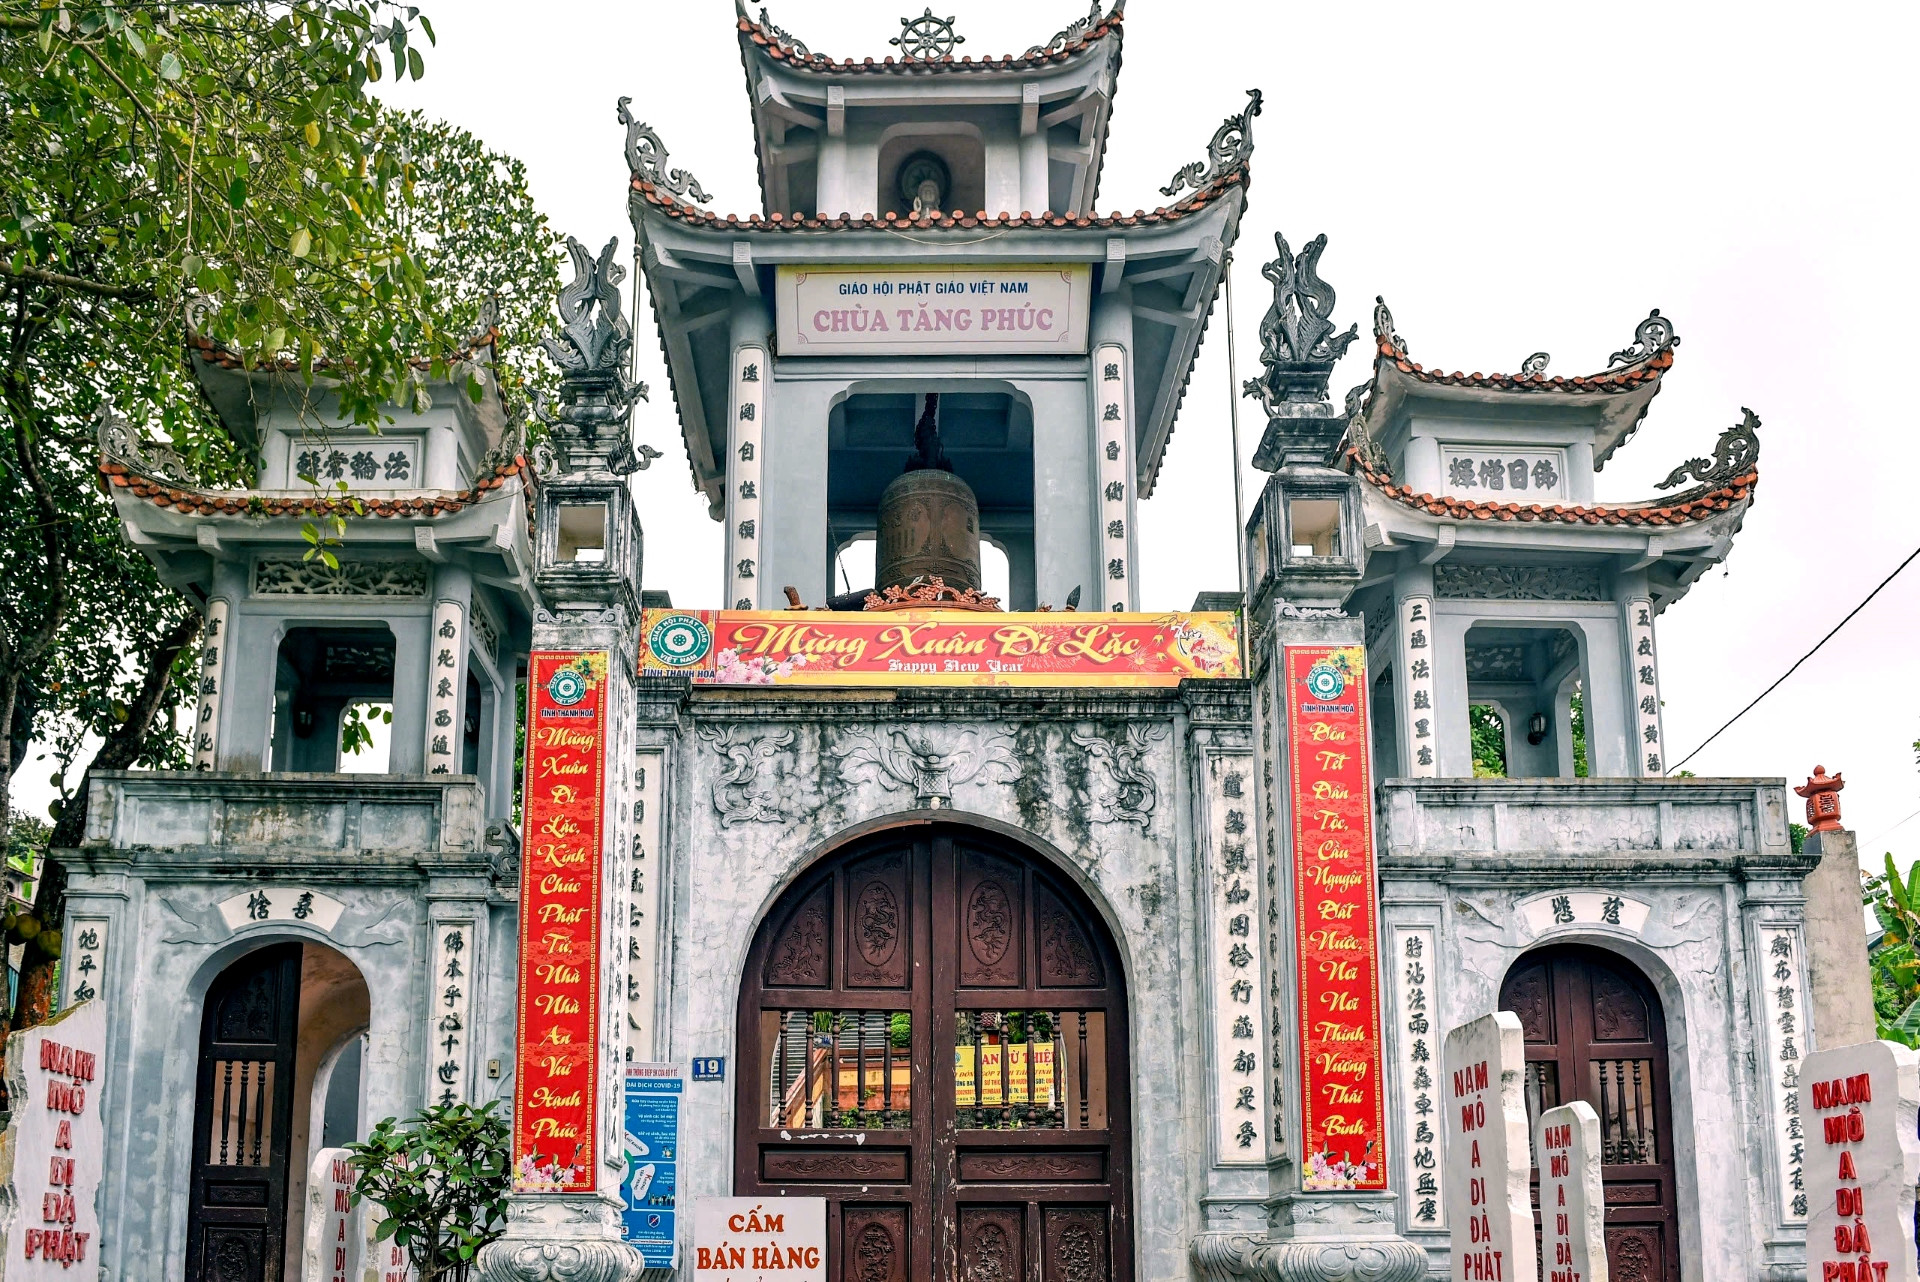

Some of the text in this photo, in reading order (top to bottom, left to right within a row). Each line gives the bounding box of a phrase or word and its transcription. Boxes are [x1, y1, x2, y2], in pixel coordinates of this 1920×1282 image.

[839, 279, 1029, 297] GIÁO HỘI PHẬT GIÁO VIỆT NAM
[813, 301, 1054, 333] CHÙA TĂNG PHÚC
[728, 622, 869, 667] Mừng
[874, 620, 988, 661] Xuân
[1058, 623, 1143, 665] Lặc
[888, 658, 1024, 675] Happy New Year
[537, 727, 595, 754] Mừng
[1309, 721, 1346, 742] Đón
[538, 753, 589, 779] Xuân
[1315, 750, 1351, 772] Tết
[536, 843, 587, 868] Kính
[1317, 839, 1349, 861] Cầu
[539, 873, 582, 895] Chúc
[1306, 865, 1363, 893] Nguyện
[538, 902, 589, 926] Phật
[1317, 898, 1361, 921] Đất
[535, 964, 582, 985] Nhà
[534, 994, 581, 1016] Nhà
[539, 1024, 572, 1047] An
[1314, 1021, 1366, 1044] Thịnh
[40, 1038, 96, 1082] NAM
[541, 1055, 573, 1078] Vui
[697, 1060, 719, 1074] 19
[981, 1053, 1000, 1065] AN
[1315, 1052, 1367, 1081] Vượng
[1453, 1060, 1489, 1098] NAM
[1811, 1072, 1872, 1110] NAM
[46, 1078, 86, 1115] MÔ
[528, 1087, 582, 1111] Hạnh
[1322, 1082, 1364, 1105] Thái
[1321, 1114, 1365, 1137] Bình
[1461, 1094, 1486, 1133] MÔ
[1824, 1105, 1865, 1145] MÔ
[54, 1119, 73, 1150] A
[531, 1117, 579, 1139] Phúc
[1545, 1123, 1572, 1150] NAM
[1471, 1139, 1481, 1169] A
[1550, 1151, 1569, 1178] MÔ
[1838, 1150, 1857, 1180] A
[50, 1155, 75, 1187] DI
[1470, 1177, 1486, 1206] DI
[1557, 1184, 1566, 1207] A
[1836, 1186, 1864, 1217] DI
[42, 1188, 77, 1223] ĐÀ
[728, 1204, 784, 1233] CẤM
[337, 1218, 345, 1242] A
[1470, 1207, 1491, 1244] ĐÀ
[1556, 1213, 1569, 1236] DI
[1834, 1217, 1872, 1254] ĐÀ
[25, 1224, 91, 1268] PHẬT
[335, 1246, 346, 1271] DI
[697, 1241, 820, 1270] BÁN HÀNG
[1556, 1238, 1572, 1266] ĐÀ
